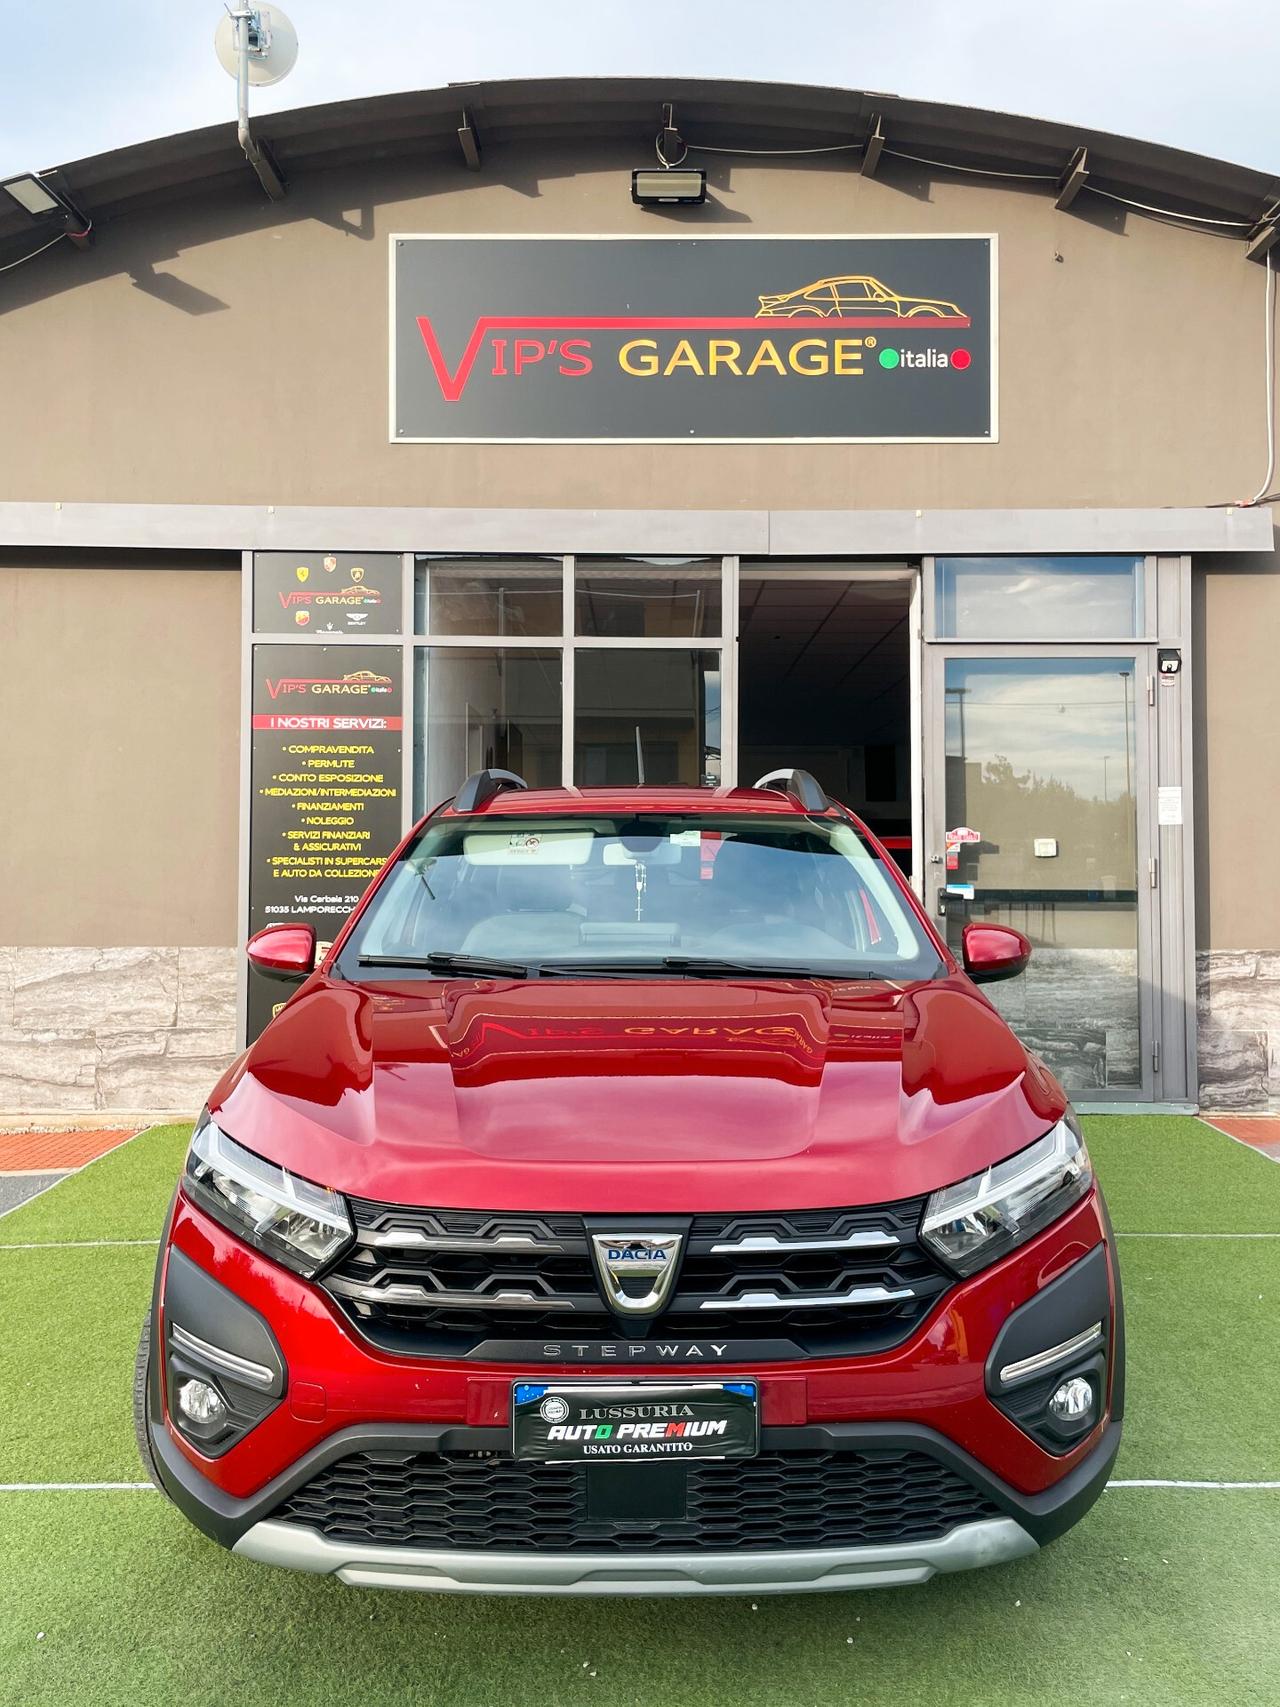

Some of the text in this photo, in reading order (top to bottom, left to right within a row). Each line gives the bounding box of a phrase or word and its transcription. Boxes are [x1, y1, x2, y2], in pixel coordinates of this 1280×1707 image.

[416, 316, 594, 402] VIP'S
[900, 348, 949, 369] italia
[266, 679, 307, 699] VIP'S
[270, 718, 387, 729] I NOSTRI SERVIZI:
[288, 745, 375, 754] COMPRAVENDITA
[308, 760, 355, 768] PERMUTE
[279, 774, 384, 783] CONTO ESPOSIZIONE
[297, 802, 365, 811] FINANZIAMENTI
[306, 817, 354, 825] NOLEGGIO
[287, 831, 371, 840] SERVIZI FINANZIARI
[293, 843, 362, 851] & ASSICURATIVI
[272, 857, 387, 866] SPECIALISTI IN SUPERCARS
[273, 870, 280, 878] E
[281, 870, 308, 878] AUTO
[309, 870, 323, 878] DA
[294, 894, 360, 903] Via Cerbaia 210
[265, 906, 290, 914] 51035
[607, 1248, 667, 1260] DACIA
[542, 1344, 728, 1357] STEPWAY
[578, 1404, 695, 1420] LUSSURIA
[546, 1420, 728, 1441] AUTO PREMIUM
[583, 1441, 693, 1455] USATO GARANTITO
